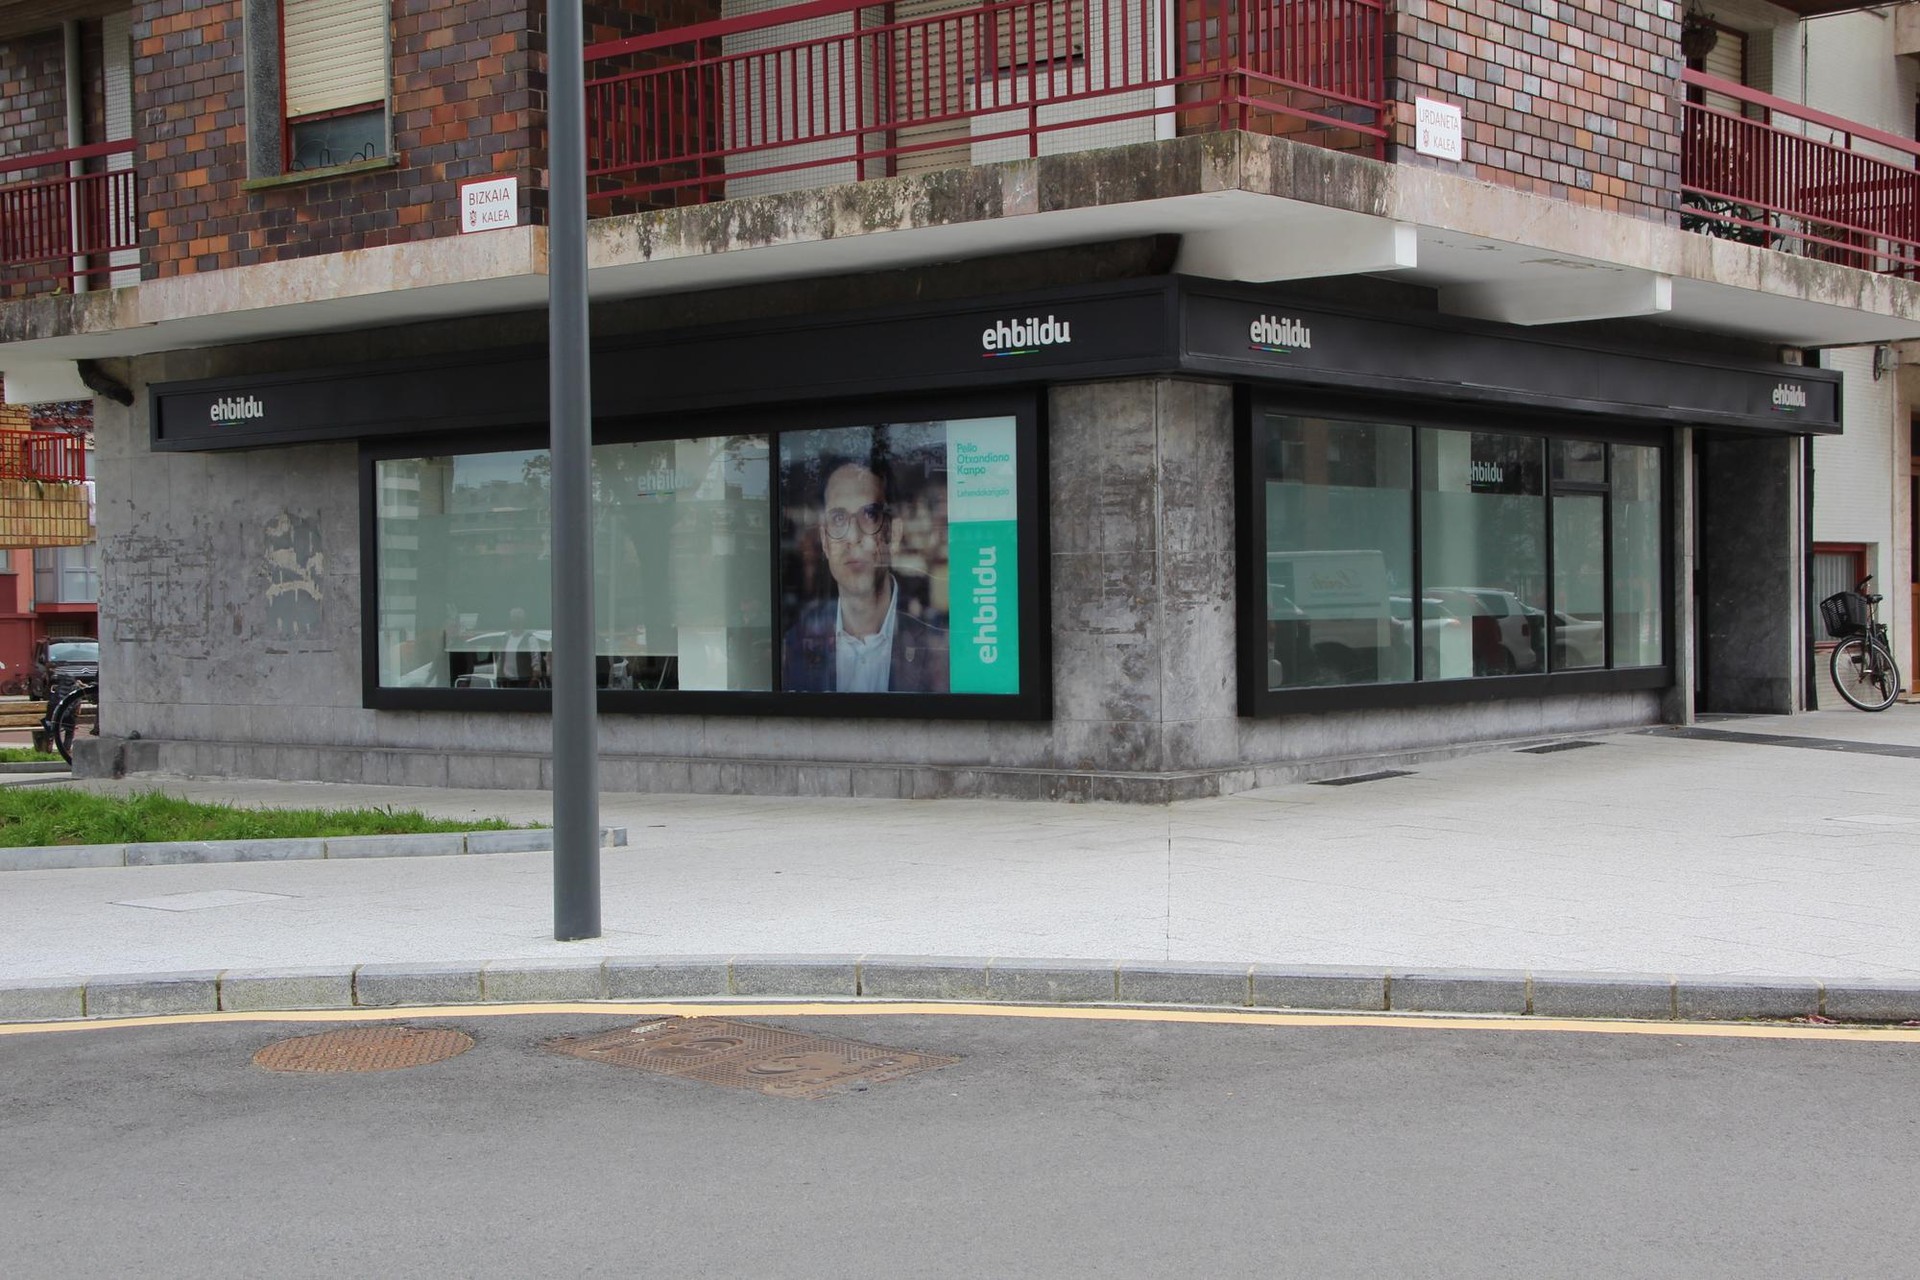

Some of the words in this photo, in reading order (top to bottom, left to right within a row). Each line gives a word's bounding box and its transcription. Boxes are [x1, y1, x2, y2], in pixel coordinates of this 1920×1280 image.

[1419, 108, 1459, 131] URDANETA
[1433, 136, 1456, 152] KALEA
[468, 187, 510, 206] BIZKAIA
[481, 209, 510, 224] KALEA
[982, 315, 1071, 350] ehbildu
[1250, 314, 1311, 349] ehbildu
[1772, 383, 1806, 407] ehbildu
[210, 395, 264, 421] ehbildu
[957, 465, 986, 477] Kanpo
[1469, 460, 1504, 482] hbildu
[972, 546, 999, 664] ehbildu
